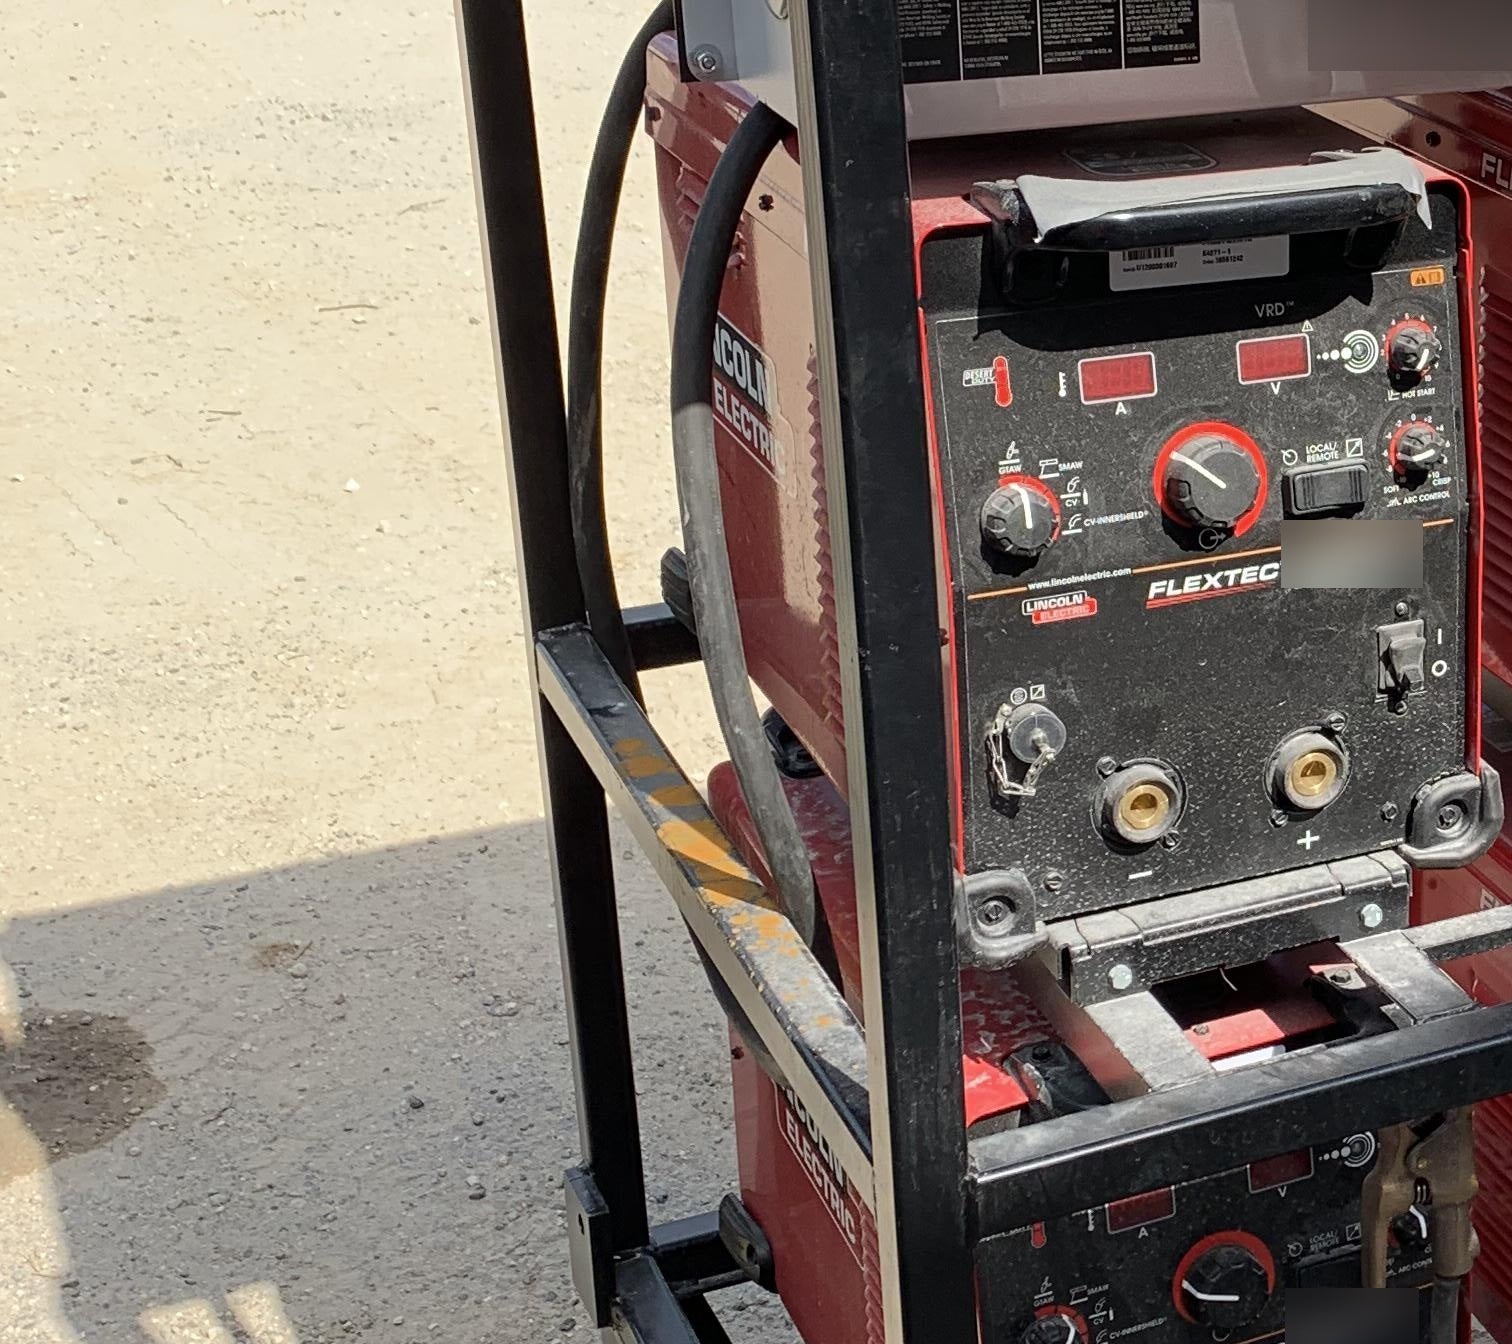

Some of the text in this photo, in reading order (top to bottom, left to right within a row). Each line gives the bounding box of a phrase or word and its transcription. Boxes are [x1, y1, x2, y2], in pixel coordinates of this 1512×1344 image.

[713, 323, 770, 413] NCOLN
[965, 369, 994, 380] DESERT
[1270, 382, 1281, 395] V
[1402, 388, 1436, 399] HOT START
[1115, 402, 1128, 415] A
[1305, 442, 1337, 454] LOCAL/
[1306, 451, 1339, 463] REMOTE
[998, 464, 1022, 474] GTAW
[1058, 460, 1084, 472] SMAW
[1433, 476, 1452, 486] CRISP
[1065, 498, 1078, 507] CV
[1403, 490, 1450, 505] ARC CONTROL
[1027, 567, 1131, 591] www.lincolnelectric.com
[1149, 561, 1281, 600] FLEXTEC
[1025, 593, 1084, 613] LINCOLN
[1040, 606, 1090, 621] ELECTRIC
[786, 1108, 857, 1244] ELECTRIC
[1277, 1187, 1288, 1198] V
[1138, 1227, 1149, 1239] A
[1308, 1229, 1338, 1244] LOCAL/
[1309, 1237, 1340, 1252] REMOTE
[1398, 1264, 1411, 1273] ARC
[1087, 1284, 1110, 1295] SMAW
[1033, 1296, 1055, 1307] GTAW
[1093, 1317, 1104, 1325] CV
